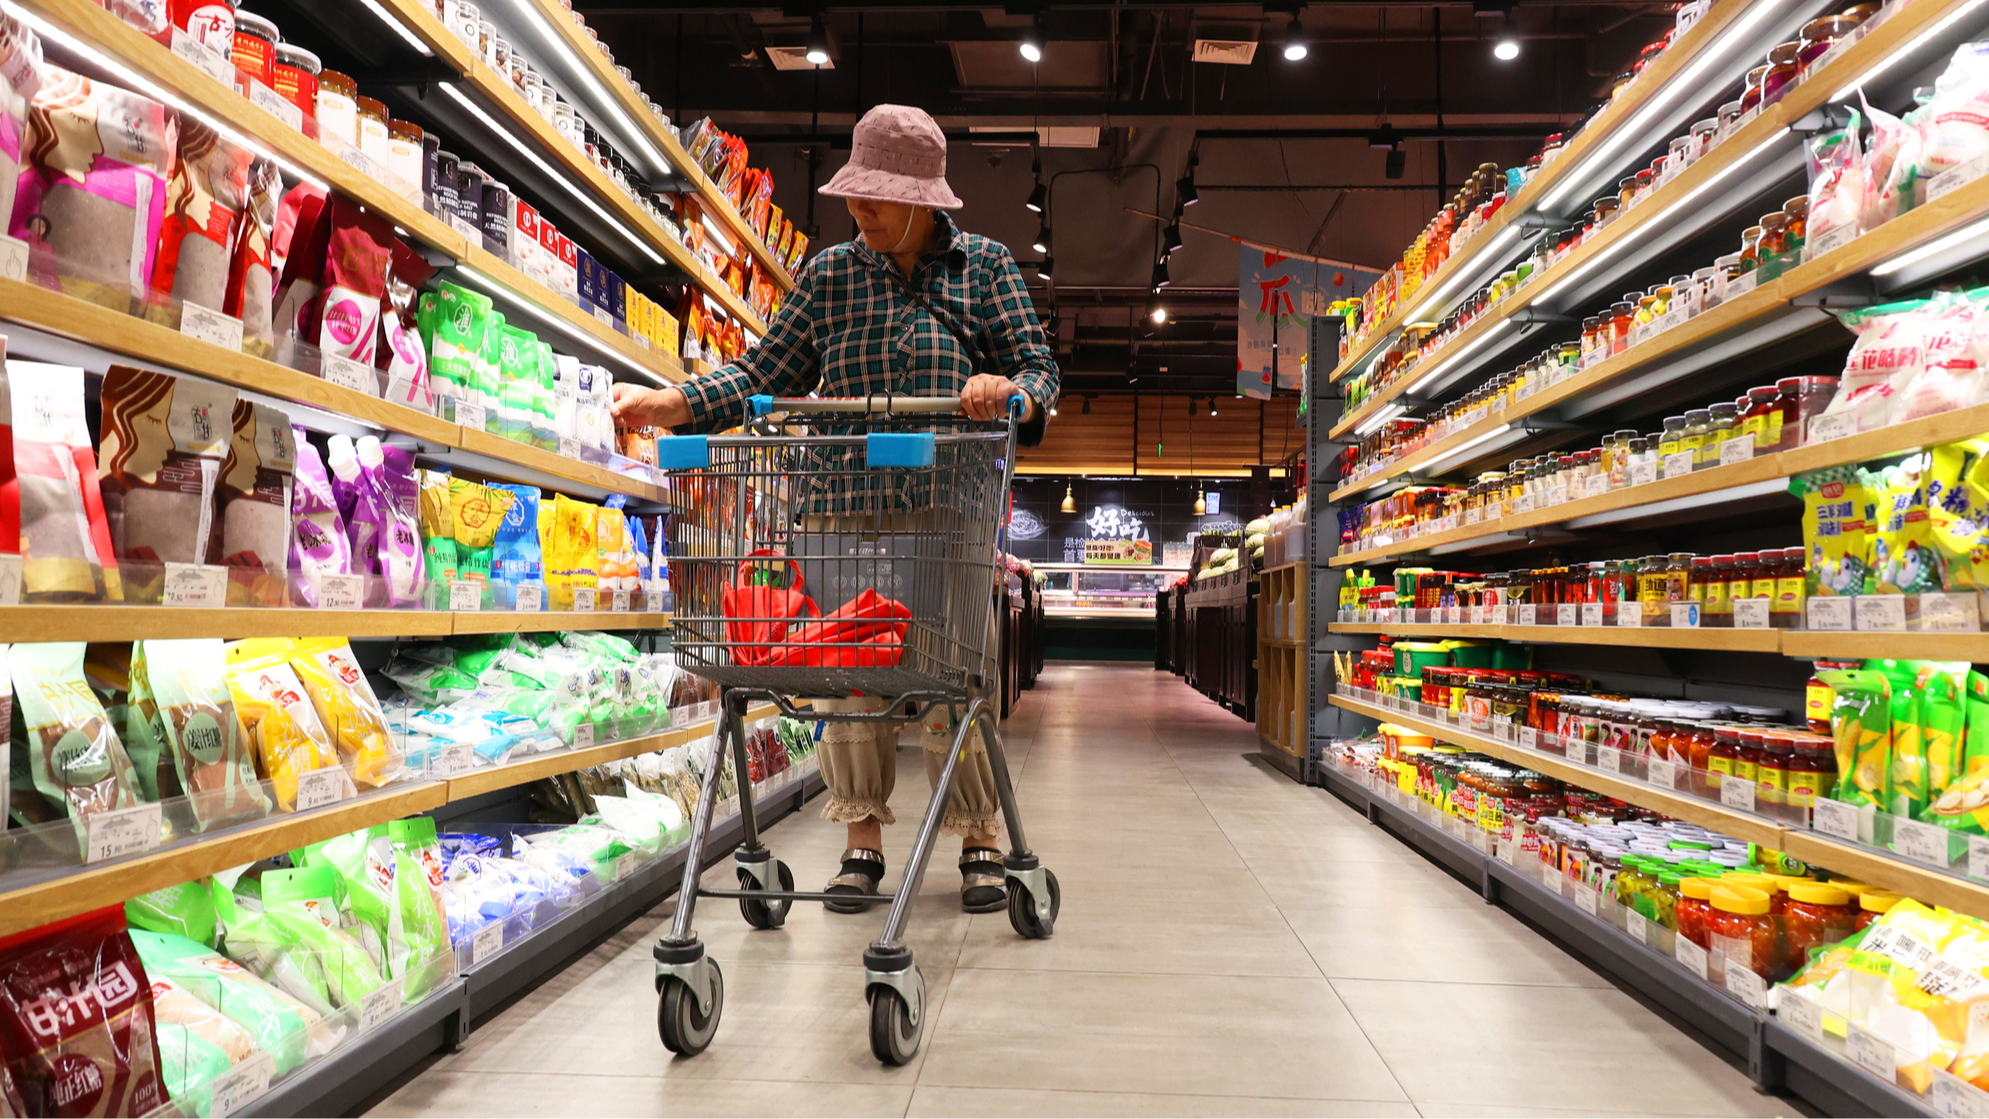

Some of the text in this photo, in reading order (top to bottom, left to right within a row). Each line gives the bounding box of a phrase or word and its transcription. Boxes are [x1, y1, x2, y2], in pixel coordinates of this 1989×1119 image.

[1086, 506, 1149, 542] 好吃
[1121, 509, 1155, 517] Delicious
[21, 959, 139, 1037] 甘汁园
